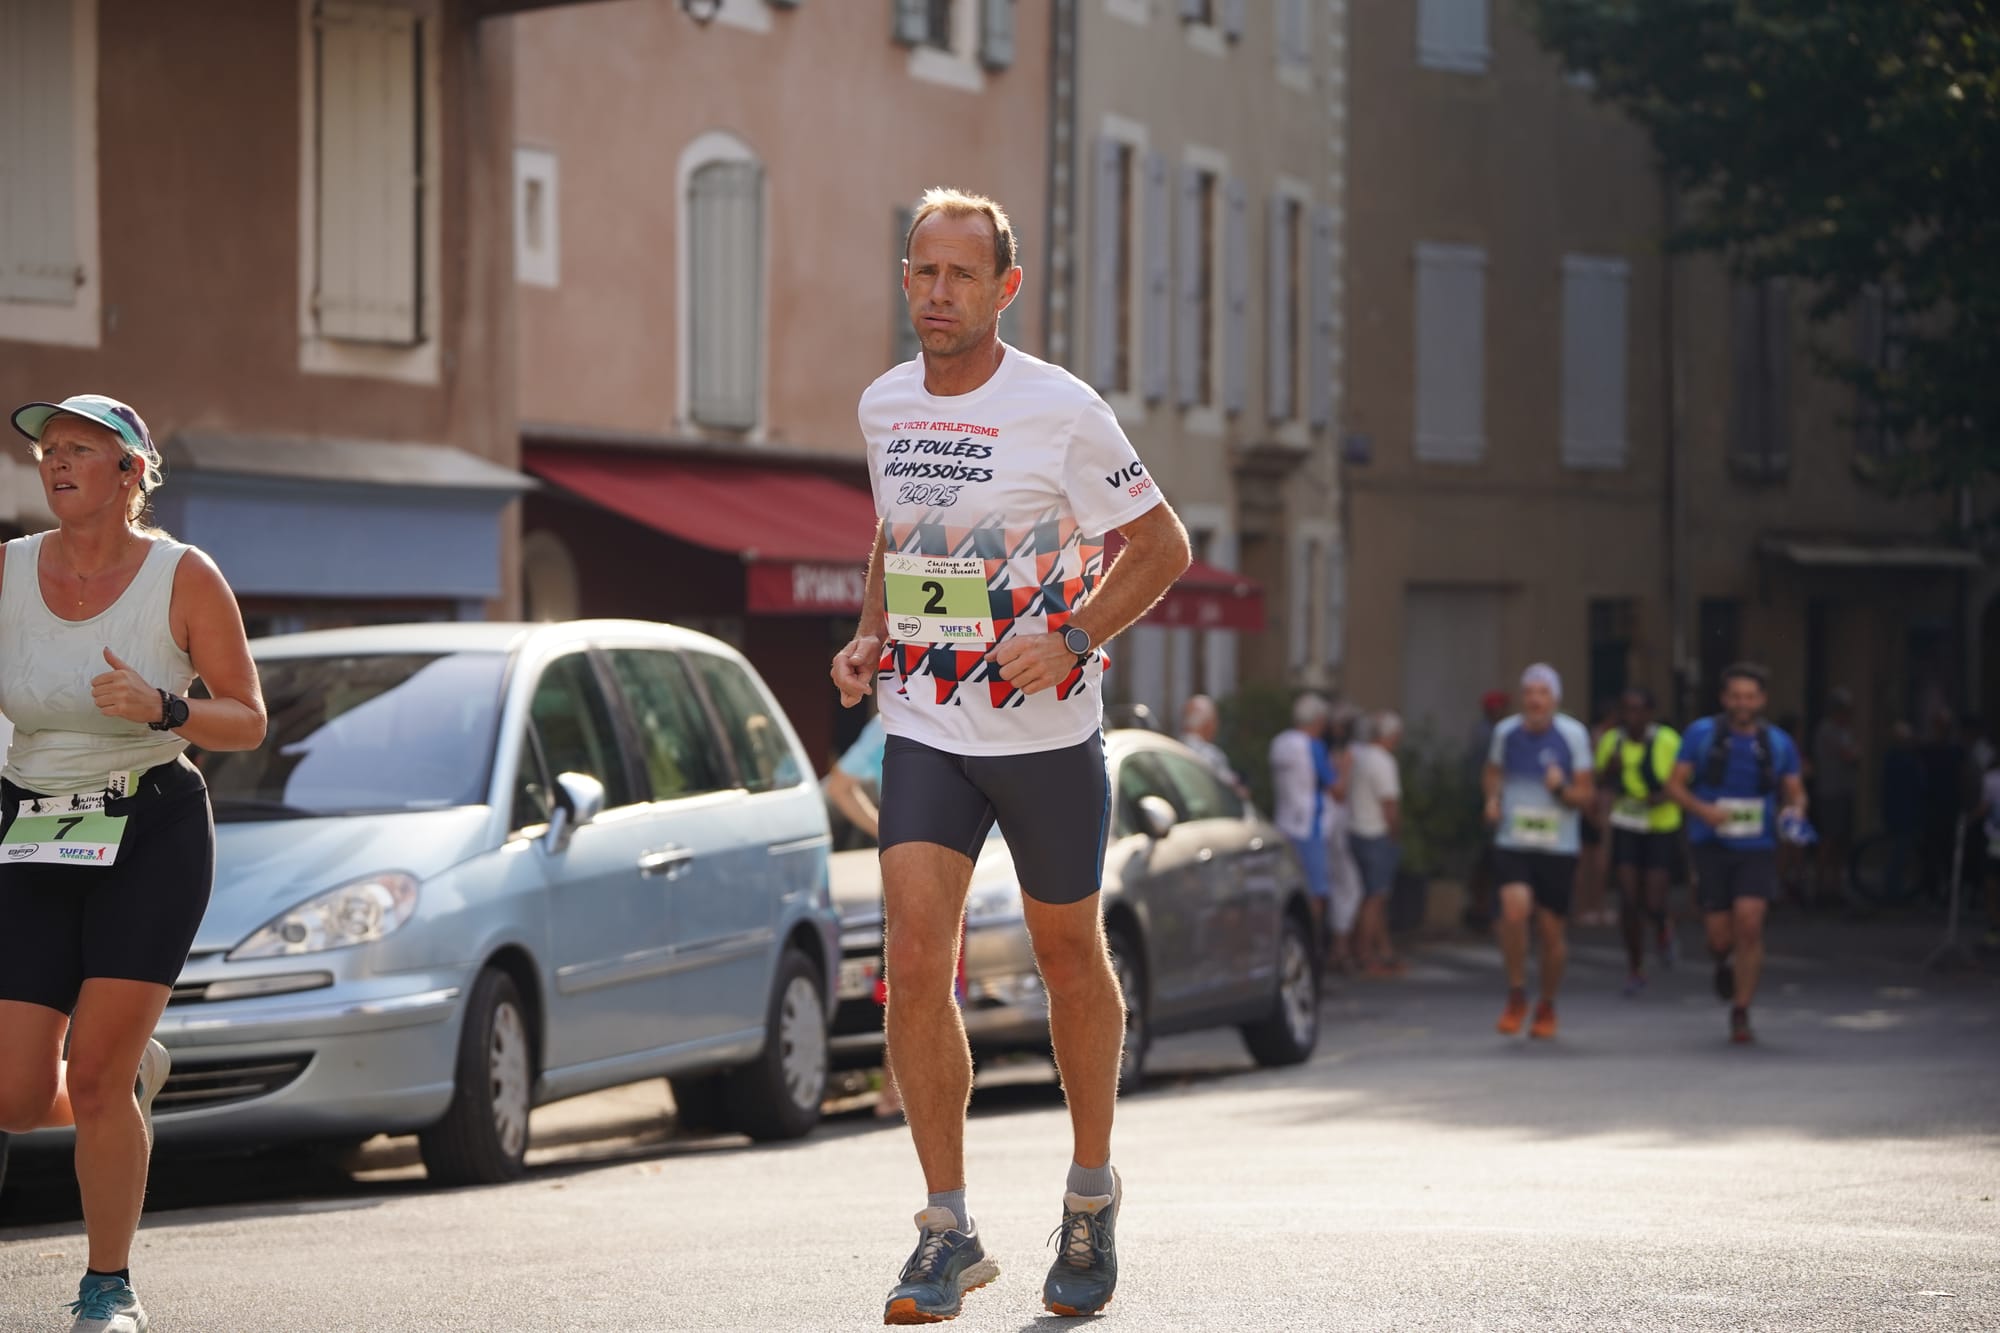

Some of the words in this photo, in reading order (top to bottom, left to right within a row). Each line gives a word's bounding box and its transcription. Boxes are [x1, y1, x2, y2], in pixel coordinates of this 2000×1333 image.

[904, 421, 929, 430] VICHY
[930, 421, 999, 437] ATHLETISME
[886, 439, 911, 454] LES
[913, 437, 993, 459] FOULÉES
[1105, 460, 1143, 488] VIC
[896, 482, 964, 507] 2025
[1128, 478, 1152, 497] SPO
[921, 581, 948, 615] 2
[53, 816, 84, 840] 7
[59, 847, 95, 855] TUFF'S
